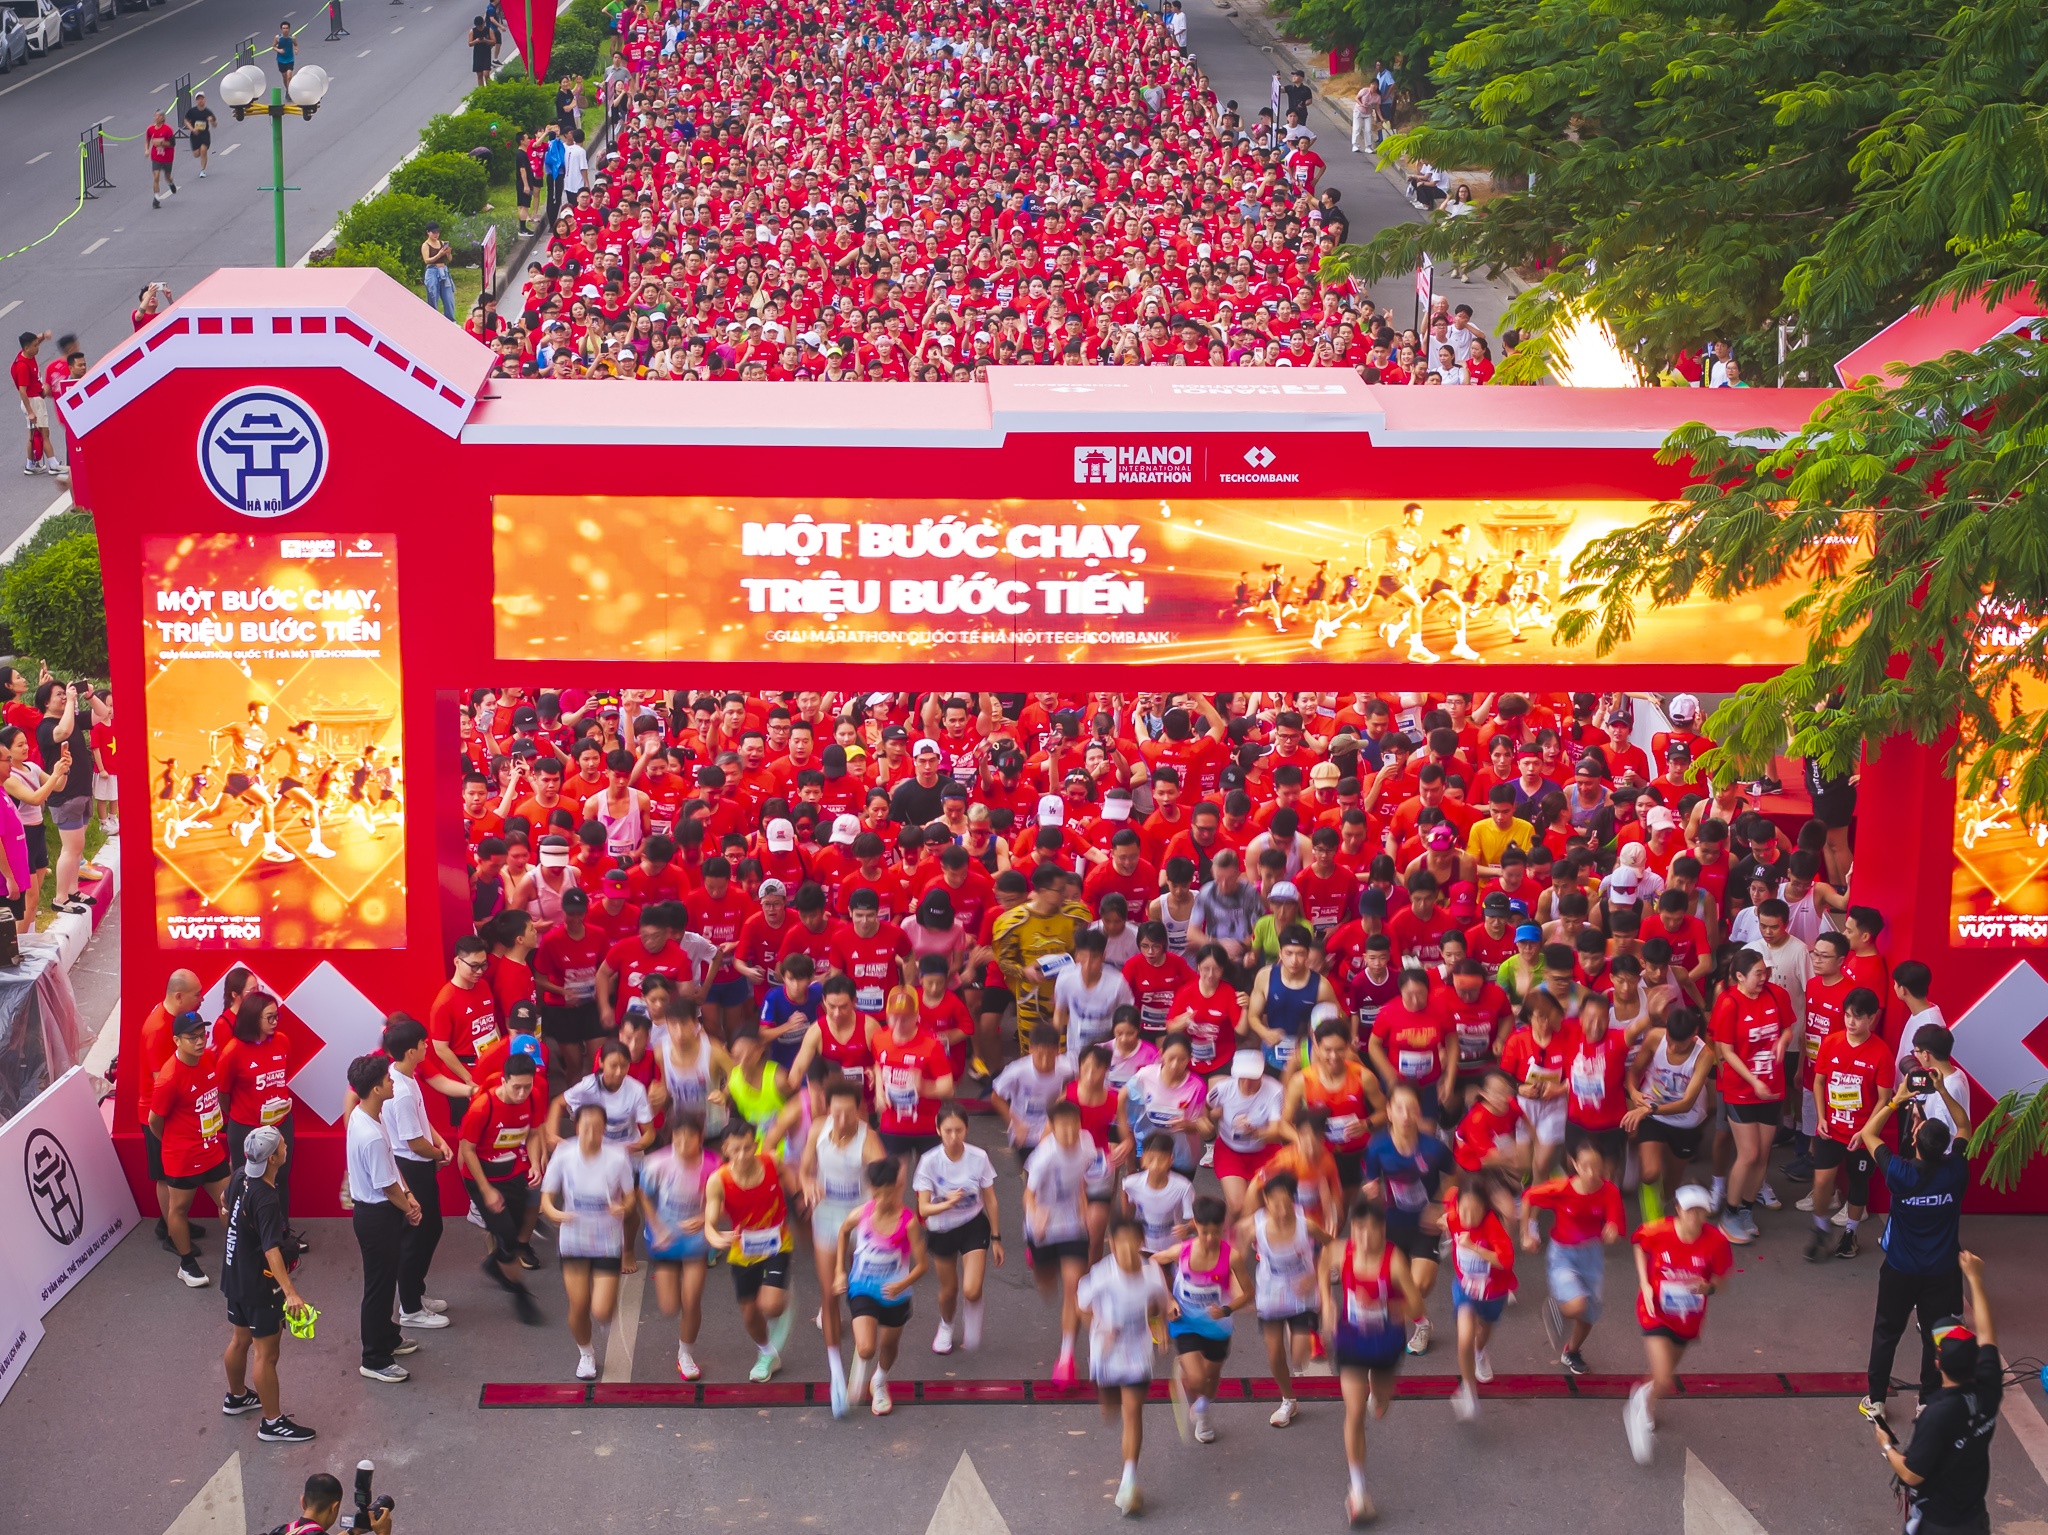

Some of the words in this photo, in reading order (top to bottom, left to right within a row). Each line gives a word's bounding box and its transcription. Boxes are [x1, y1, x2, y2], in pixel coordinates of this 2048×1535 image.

[1118, 446, 1192, 465] HANOI
[1118, 471, 1192, 483] MARATHON
[1219, 474, 1299, 483] TECHCOMBANK
[246, 498, 261, 511] HÀ
[264, 498, 282, 514] NỘI
[741, 514, 851, 566] MỘT
[859, 515, 998, 558] BƯỚC
[1005, 524, 1147, 568] CHẠY,
[157, 586, 216, 616] MỘT
[221, 585, 298, 611] BƯỚC
[302, 589, 381, 614] CHẠY,
[740, 570, 881, 622] TRIỆU
[889, 571, 1031, 614] BƯỚC
[1037, 571, 1145, 615] TIẾN
[157, 617, 233, 646] TRIỆU
[240, 617, 317, 643] BƯỚC
[322, 615, 381, 642] TIẾN
[811, 630, 901, 643] MARATHON
[907, 629, 955, 645] QUỐC
[1045, 631, 1170, 644] TECHCOMBANK
[1310, 906, 1321, 919] 5
[168, 923, 217, 940] VƯỢT
[219, 923, 261, 940] TRỘI
[1958, 921, 2006, 940] VƯỢT
[2008, 921, 2048, 940] TRỘI
[472, 1017, 481, 1035] 5
[1807, 1011, 1816, 1027] 5
[255, 1073, 266, 1090] 5
[1831, 1071, 1842, 1085] 5
[194, 1094, 204, 1113] 5
[1831, 1092, 1837, 1100] D
[1858, 1159, 1867, 1172] 8
[1902, 1193, 1953, 1206] MEDIA
[75, 1252, 88, 1269] THAO
[87, 1244, 95, 1258] VÀ
[93, 1240, 100, 1252] DU
[99, 1230, 110, 1246] LỊCH
[107, 1224, 116, 1238] HÀ
[113, 1217, 123, 1232] NỘI
[226, 1226, 237, 1266] EVENT
